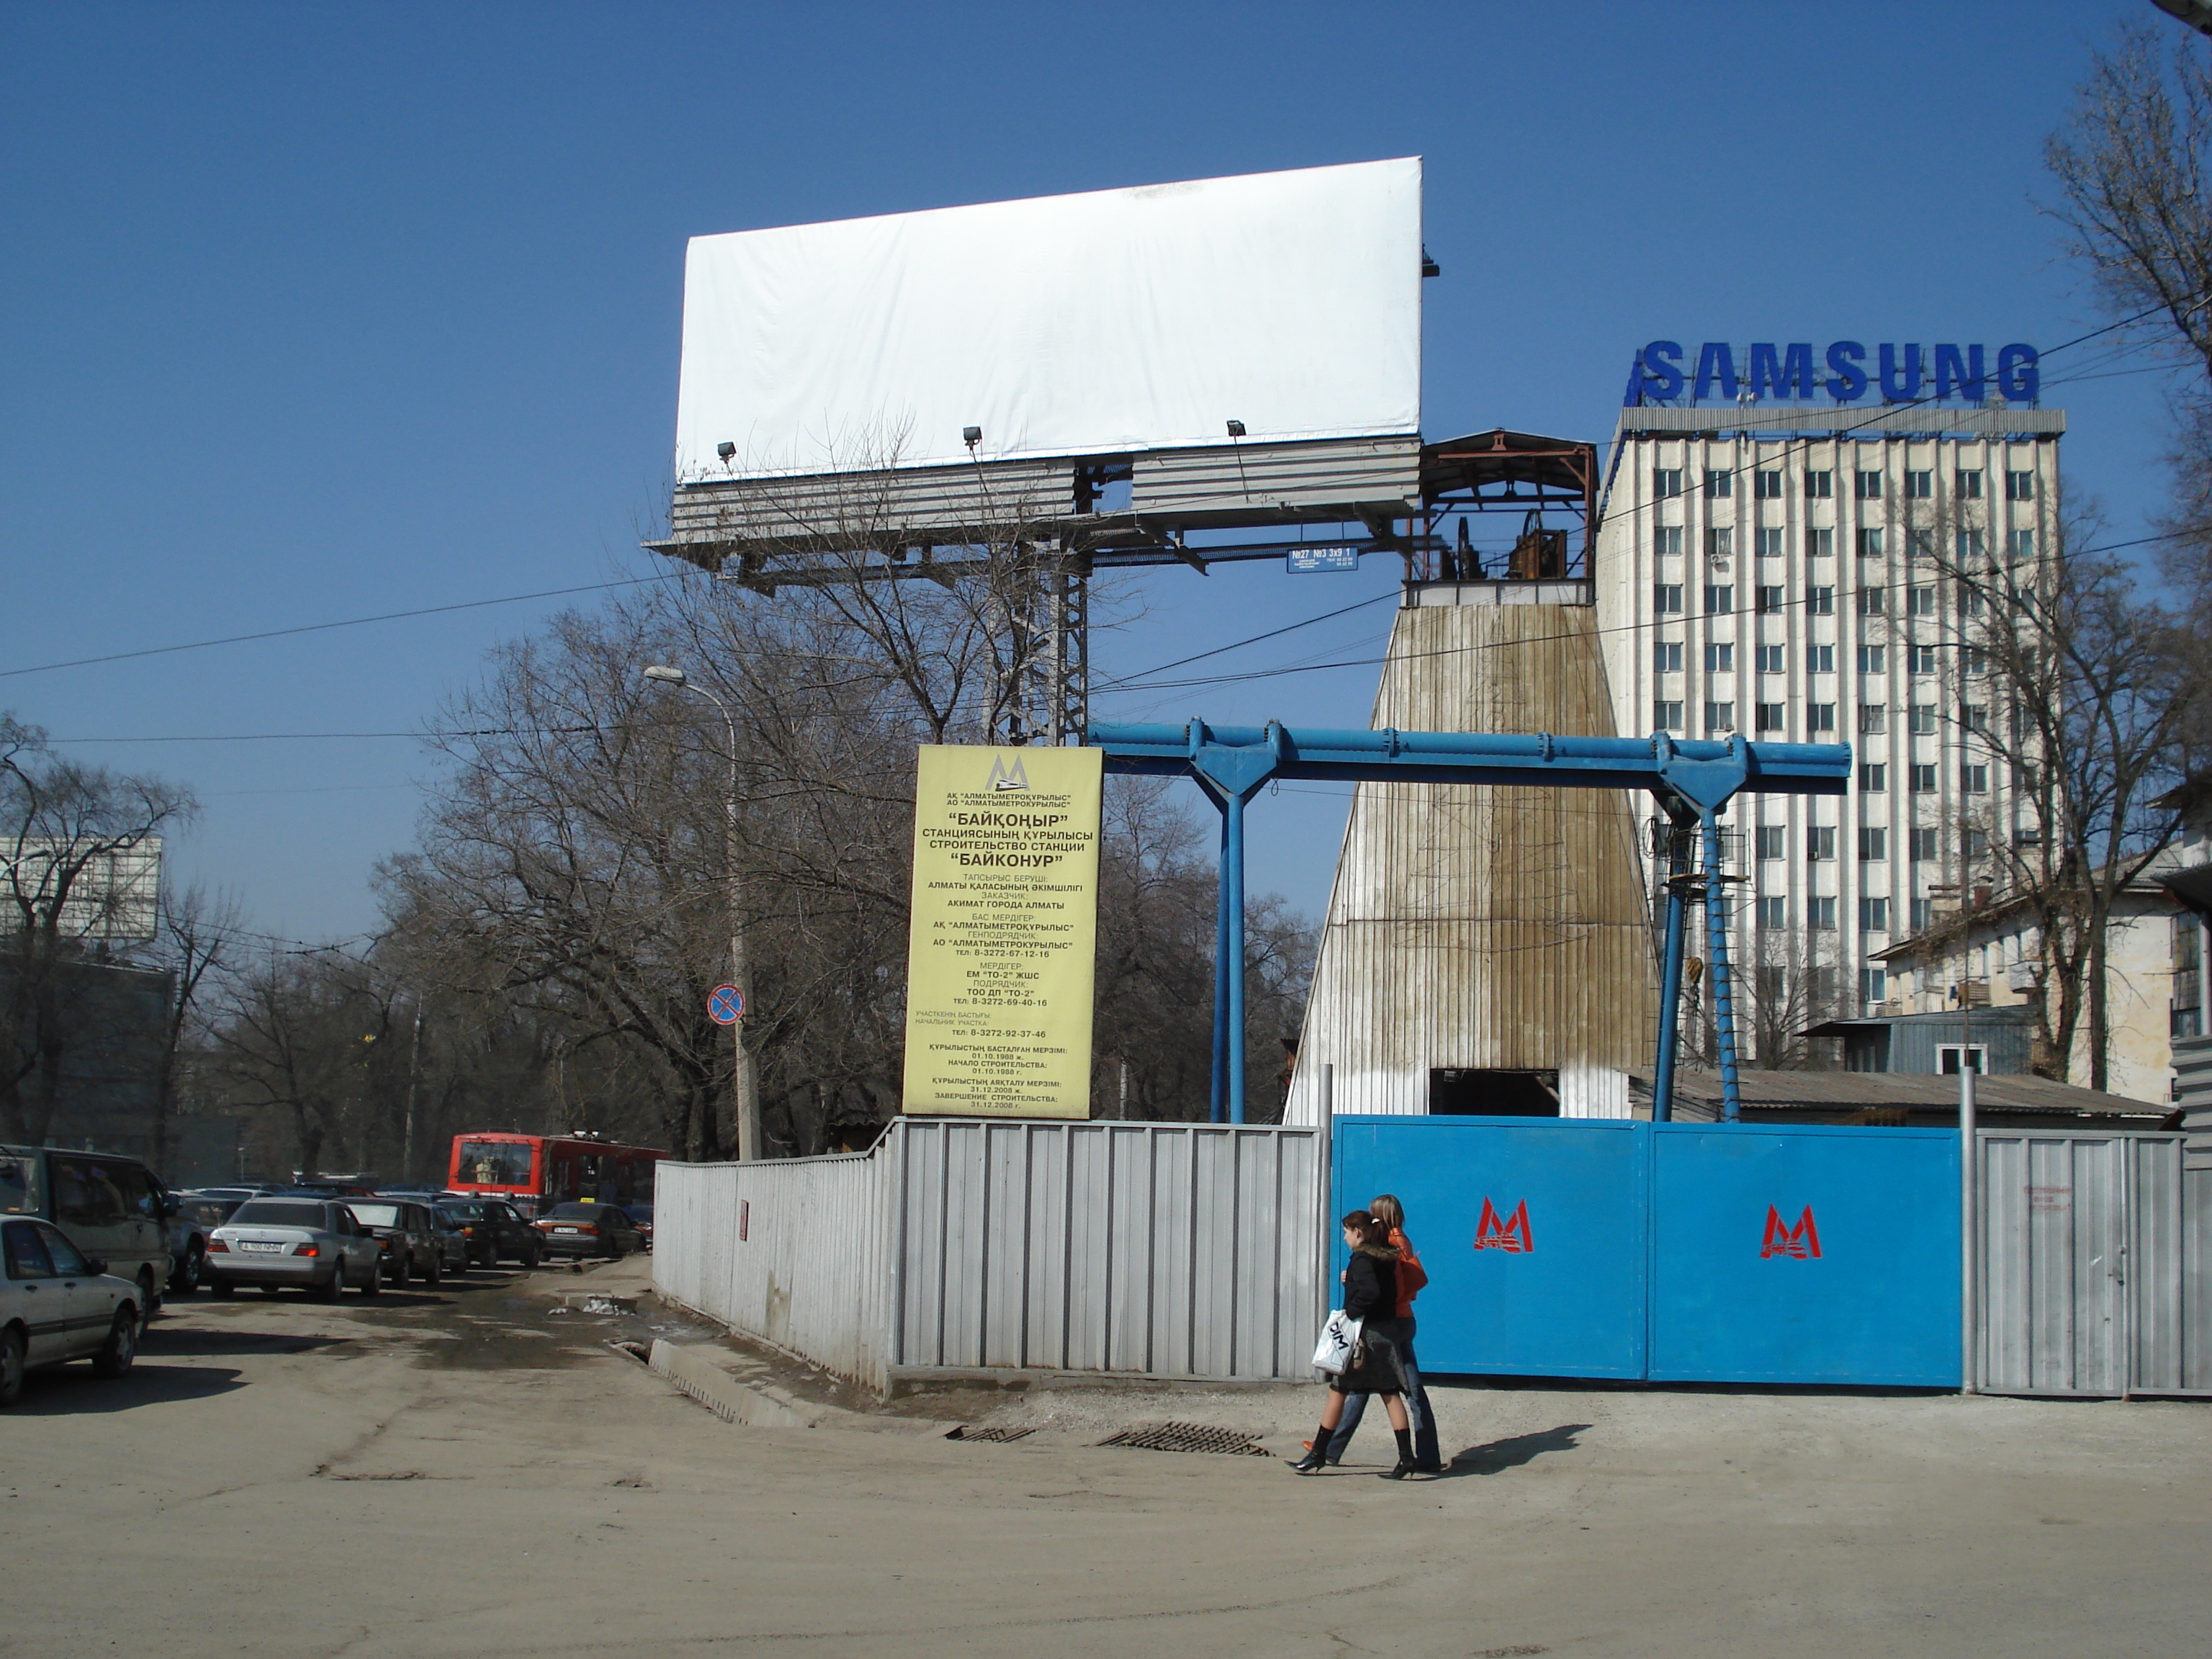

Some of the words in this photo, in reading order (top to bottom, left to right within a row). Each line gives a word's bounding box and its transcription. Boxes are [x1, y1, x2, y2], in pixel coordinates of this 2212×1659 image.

[1642, 340, 2040, 401] SAMSUNG
[949, 811, 1067, 829] “БАЙҚОҢЫР”
[922, 828, 1019, 841] СТАНЦИЯСЫНЫҢ
[1024, 831, 1093, 841] ҚҰРЫЛЫСЫ
[930, 840, 1027, 850] СТРОИТЕЛЬСТВО
[1031, 842, 1084, 853] СТАНЦИИ
[950, 851, 1063, 867] “БАЙКОНУР”
[971, 883, 1028, 891] ҚАЛАСЫНЫҢ
[968, 931, 1038, 940] ГЕНПОДРЯДЧИК:
[975, 949, 1049, 958] 8-3272-67-12-16
